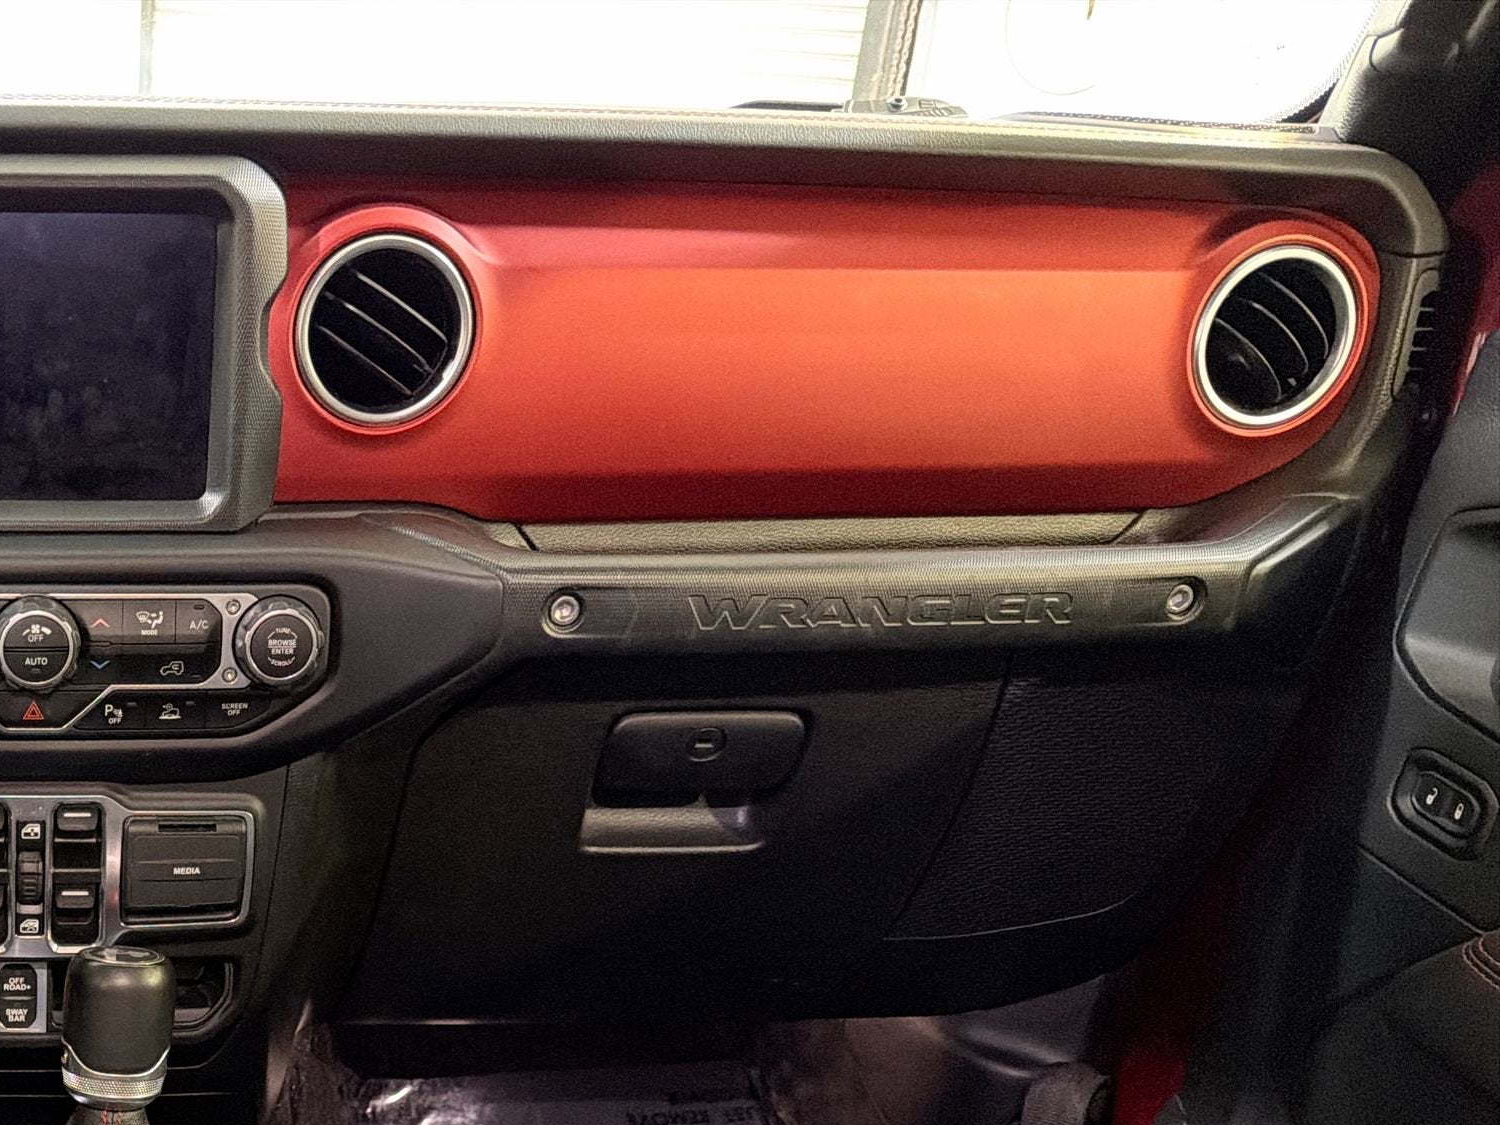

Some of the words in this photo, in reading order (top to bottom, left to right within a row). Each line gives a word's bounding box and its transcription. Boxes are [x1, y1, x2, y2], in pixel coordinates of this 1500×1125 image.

[687, 592, 1074, 631] WRANGLER
[189, 620, 209, 631] A/C
[274, 627, 292, 635] TUNE
[27, 634, 44, 643] OFF
[268, 638, 297, 646] BROWSE
[24, 657, 48, 666] AUTO
[108, 717, 122, 725] OFF
[172, 866, 201, 875] MEDIA
[3, 983, 32, 991] ROAD+
[5, 1008, 29, 1016] SWAY
[8, 1014, 26, 1022] BAR
